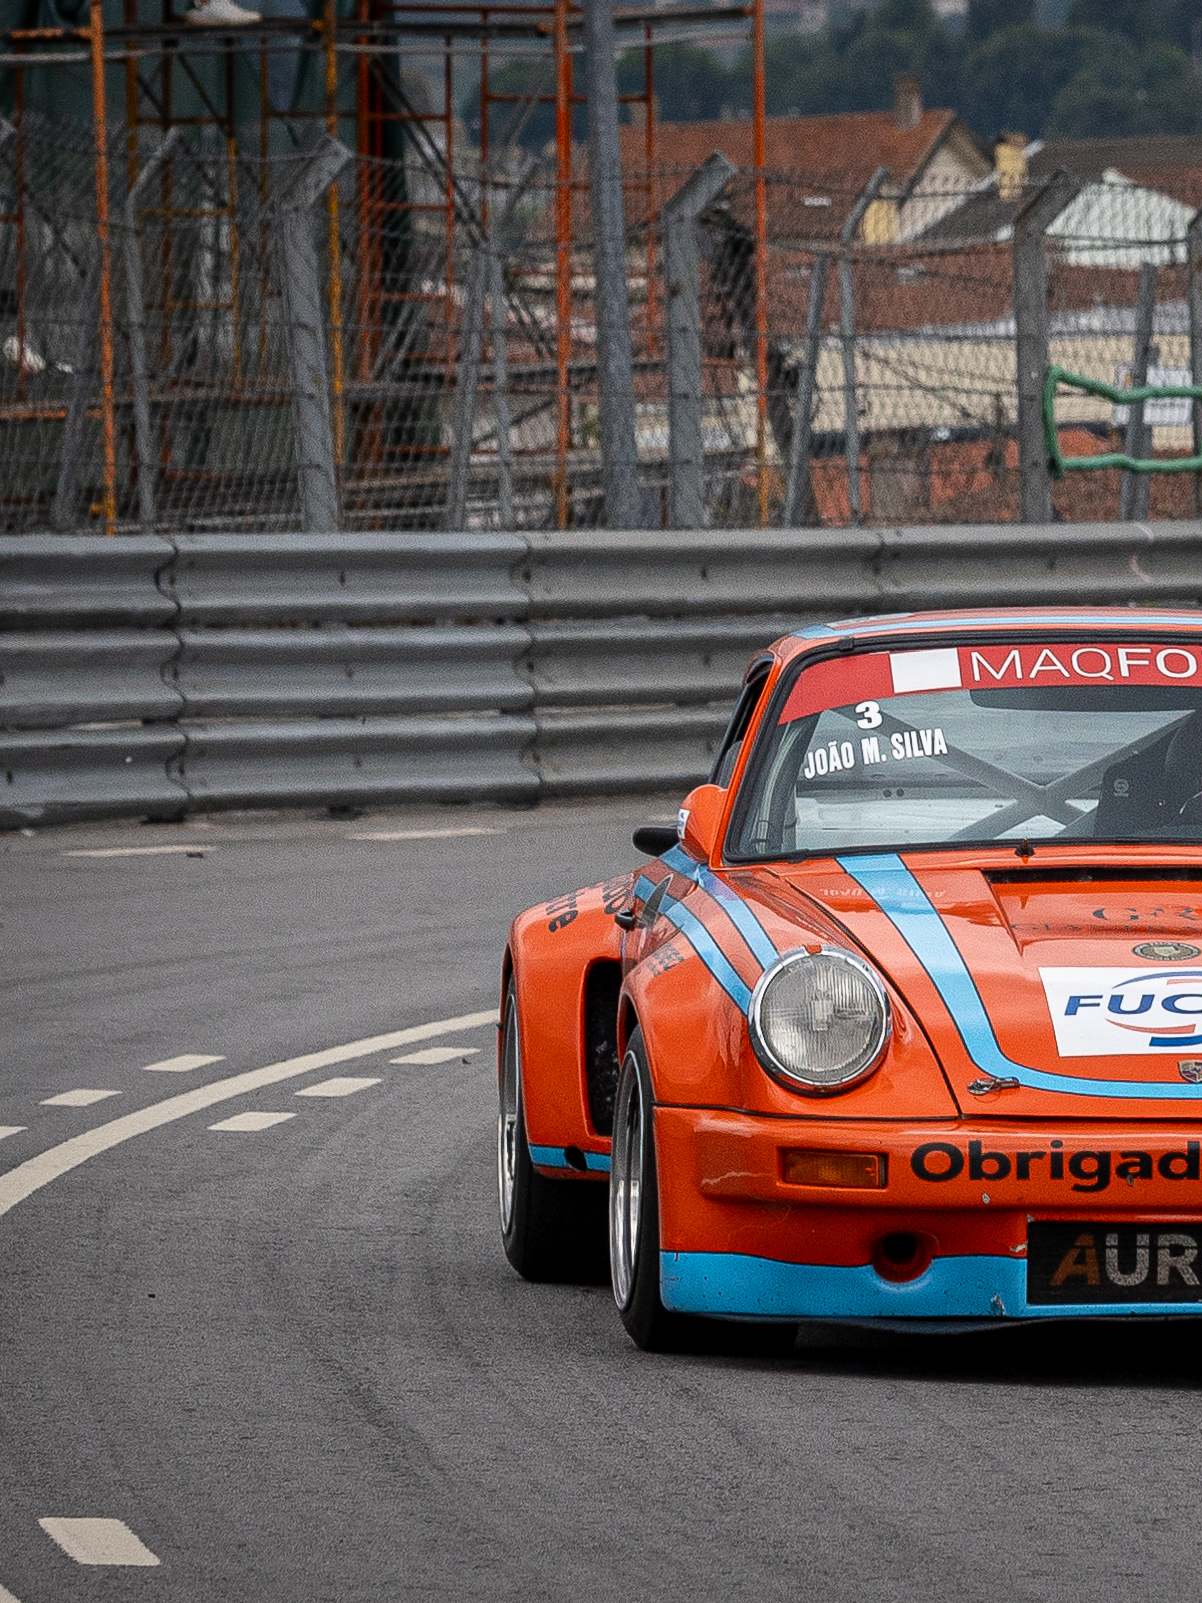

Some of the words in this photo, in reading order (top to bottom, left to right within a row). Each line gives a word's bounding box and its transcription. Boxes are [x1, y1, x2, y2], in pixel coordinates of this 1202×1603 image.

[854, 700, 884, 730] 3
[803, 740, 856, 780] JOÃO
[860, 736, 888, 766] M.
[890, 727, 949, 761] SILVA
